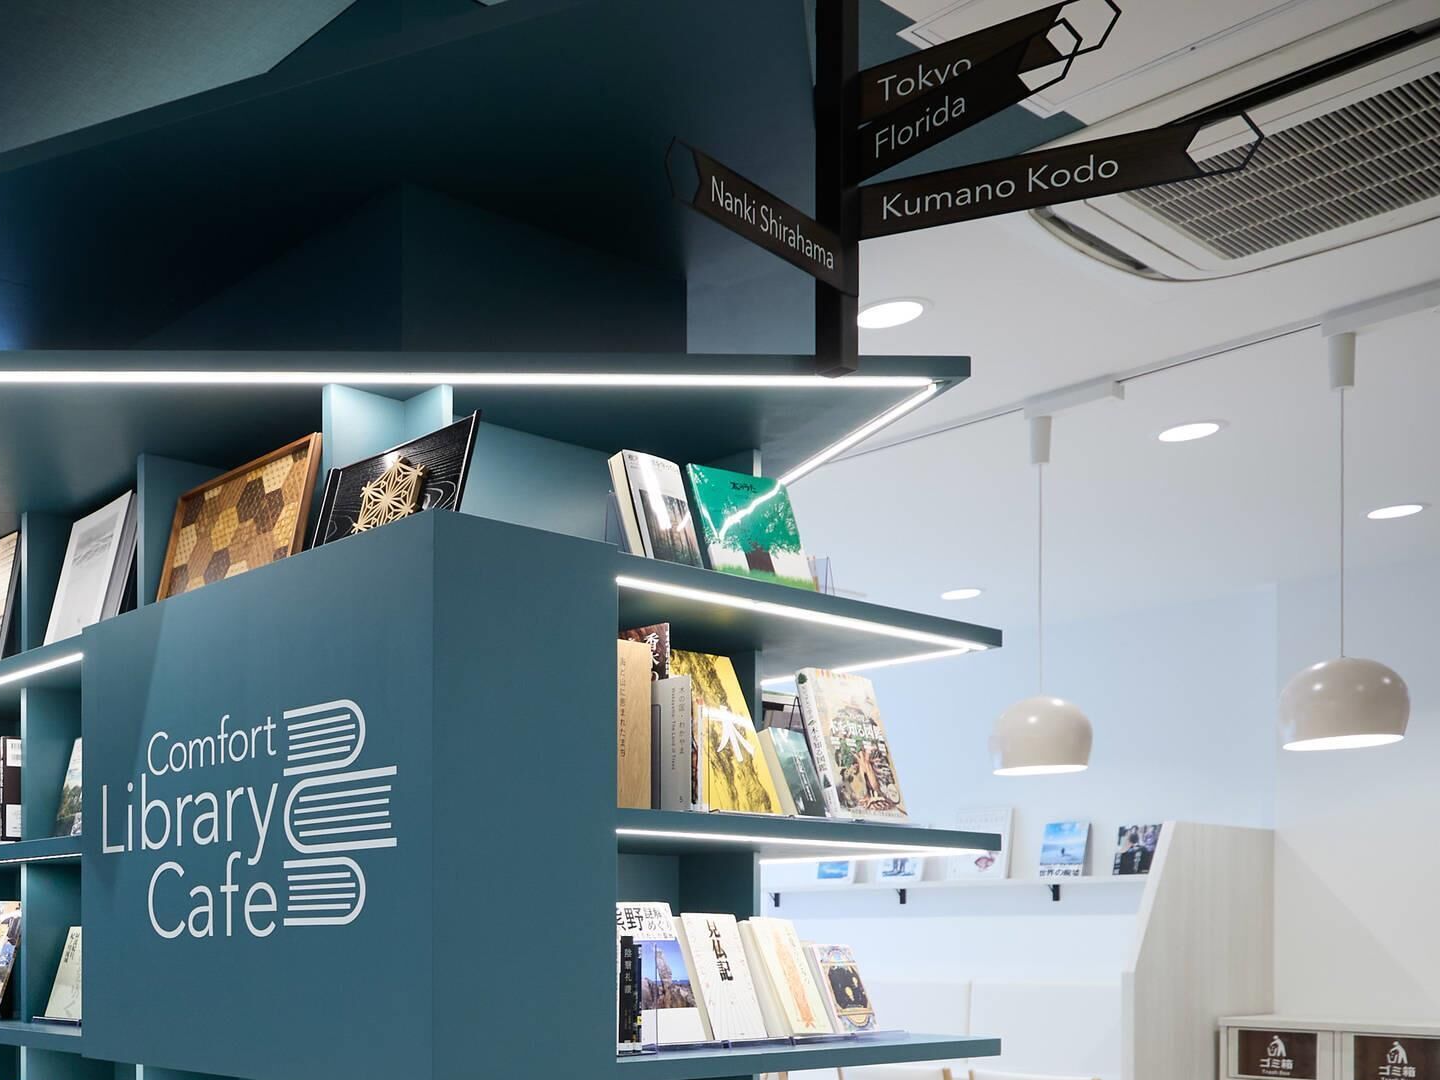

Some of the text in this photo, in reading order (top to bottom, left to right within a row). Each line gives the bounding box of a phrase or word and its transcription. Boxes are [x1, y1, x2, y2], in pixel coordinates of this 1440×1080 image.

[875, 95, 966, 159] Florida
[882, 153, 1120, 221] Kumano Kodo
[711, 175, 834, 270] Nanki Shirahama
[147, 714, 277, 776] Comfort
[101, 773, 279, 866] Library
[147, 851, 278, 939] Cafe
[1259, 1057, 1294, 1070] ゴミ箱
[1377, 1064, 1416, 1078] ゴミ箱
